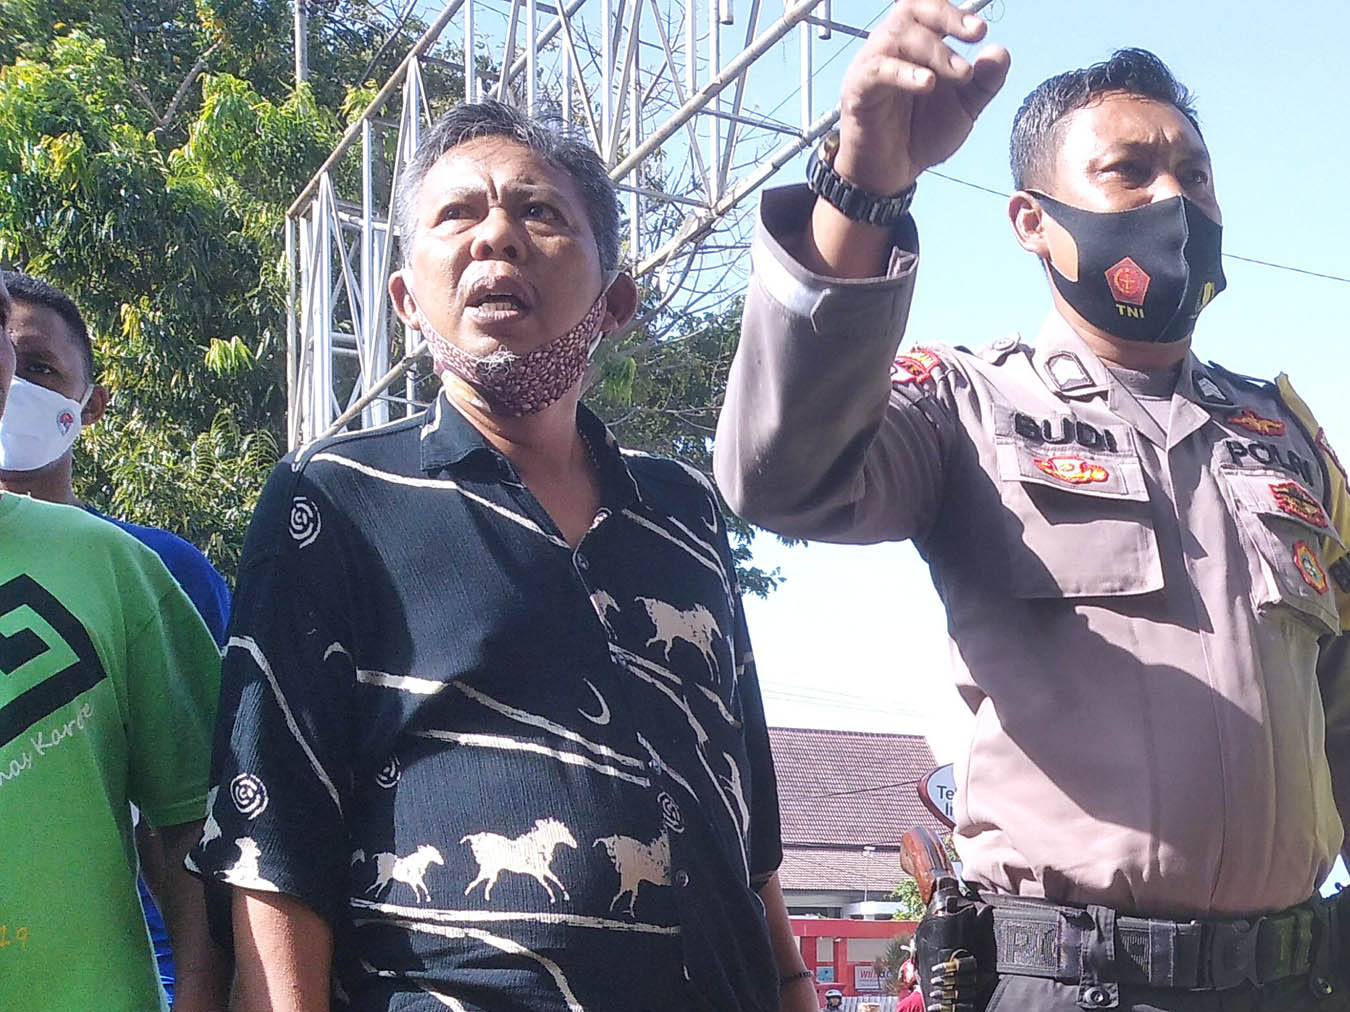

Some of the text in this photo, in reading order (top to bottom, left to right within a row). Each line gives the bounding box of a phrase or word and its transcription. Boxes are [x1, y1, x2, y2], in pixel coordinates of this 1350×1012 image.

[1115, 303, 1145, 319] TNI
[1013, 411, 1119, 454] BUDI
[1225, 440, 1314, 487] POLRI
[936, 784, 957, 801] Te
